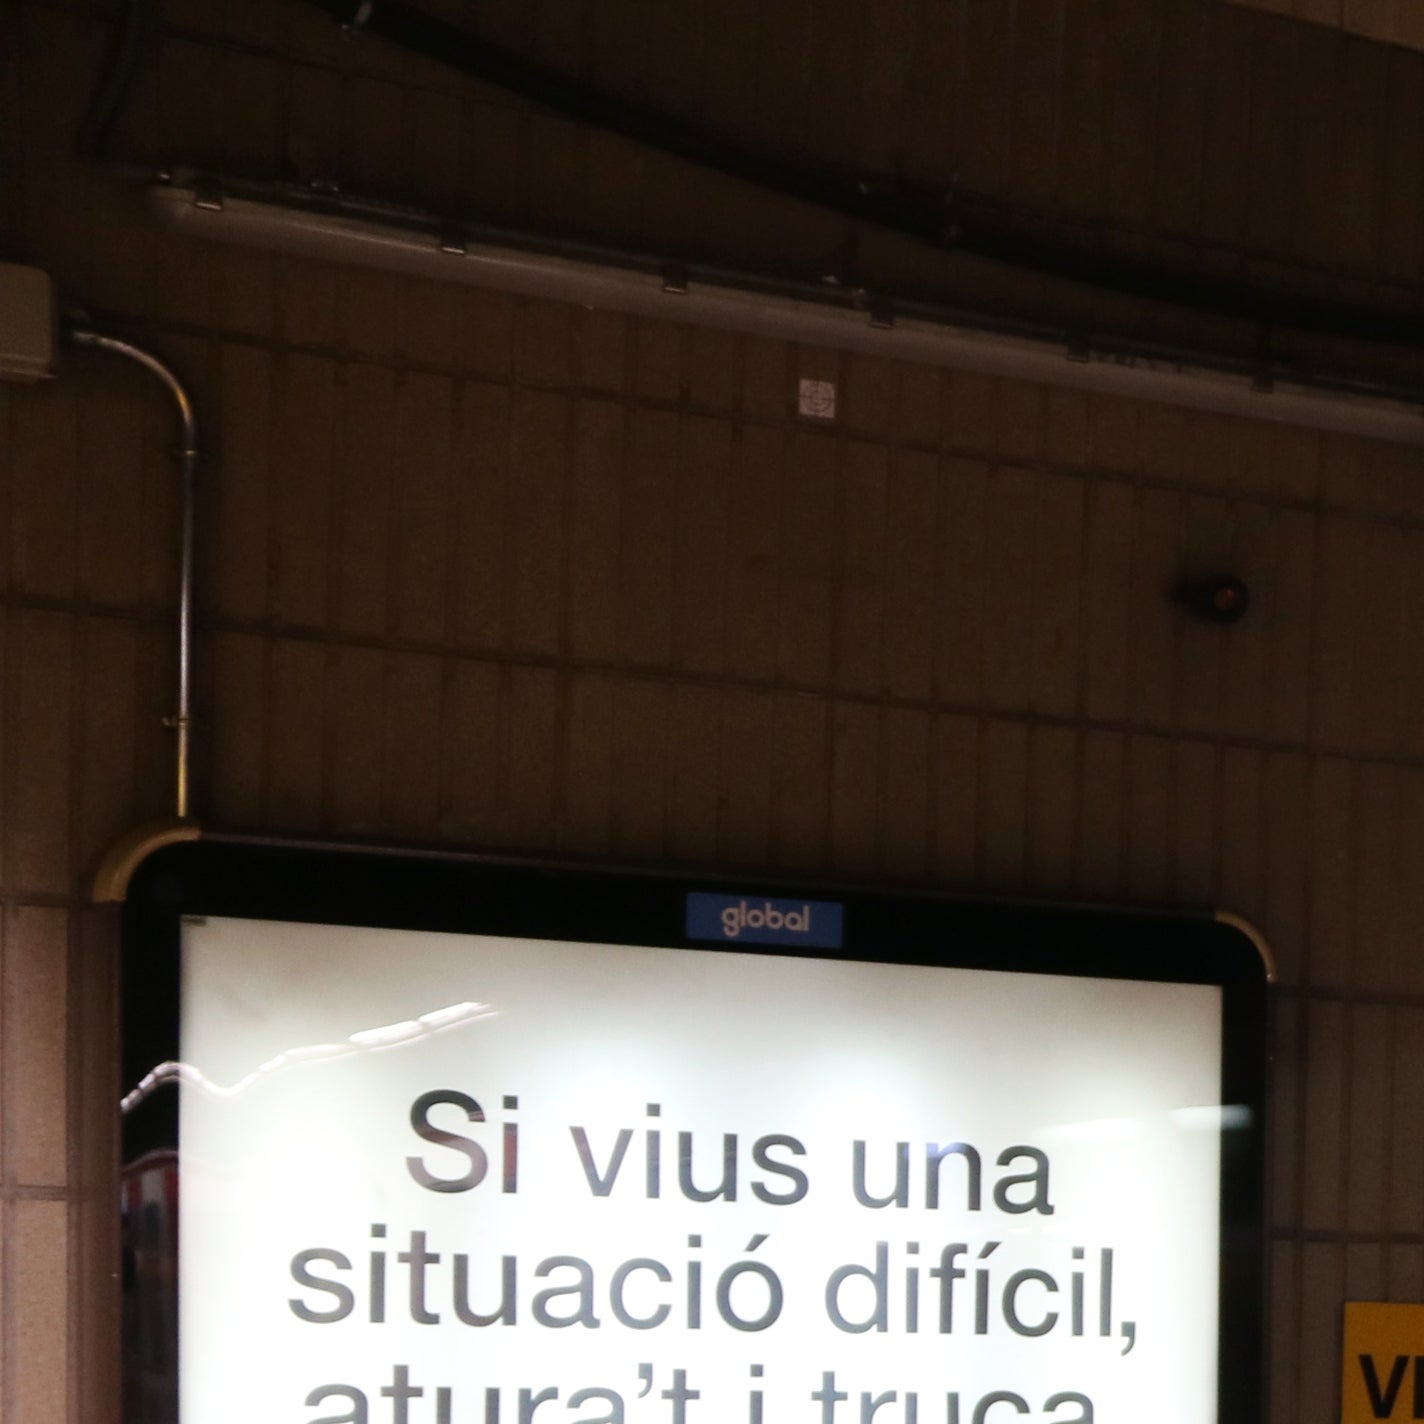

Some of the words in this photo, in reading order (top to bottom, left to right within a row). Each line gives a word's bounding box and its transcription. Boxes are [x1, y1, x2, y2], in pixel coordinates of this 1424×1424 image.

[720, 900, 811, 938] global
[407, 1089, 518, 1194] Si
[571, 1104, 808, 1205] vius
[854, 1141, 1054, 1215] una
[289, 1224, 783, 1332] situació
[826, 1242, 1135, 1355] difícil,
